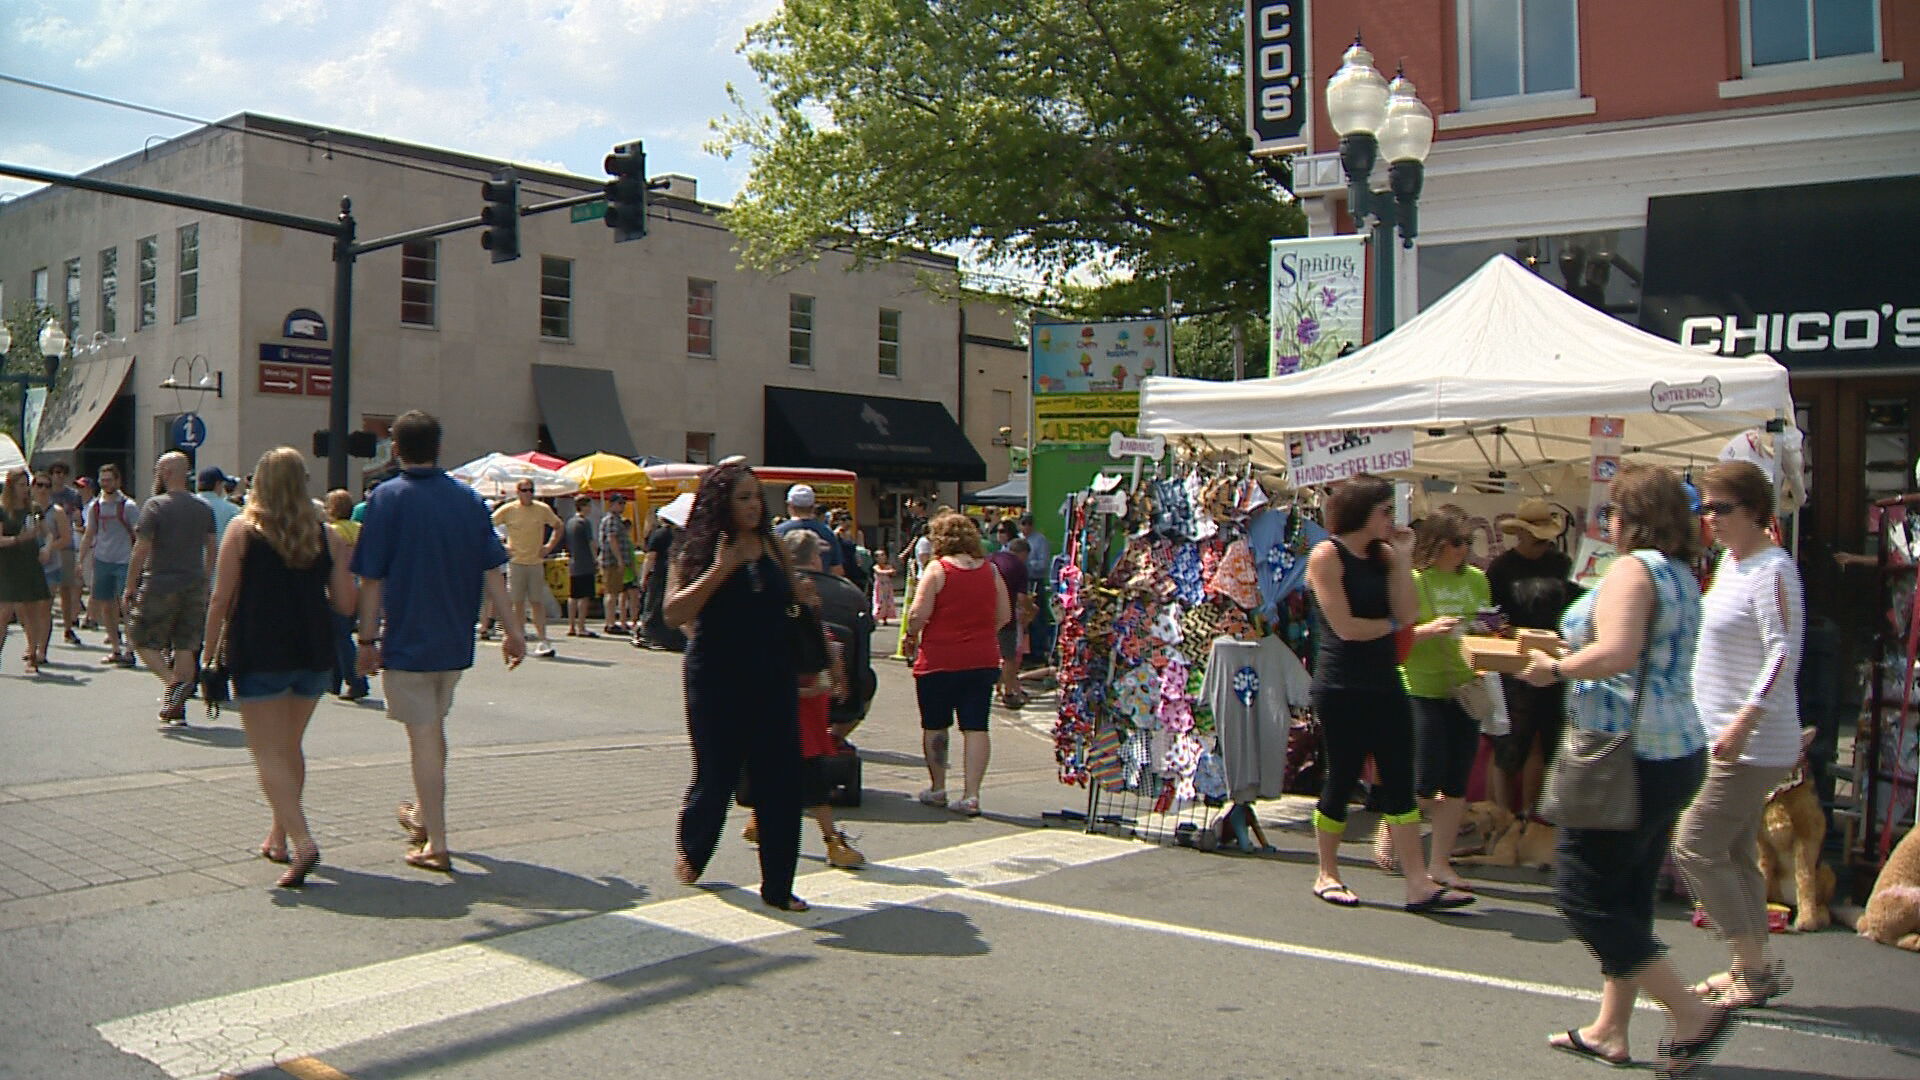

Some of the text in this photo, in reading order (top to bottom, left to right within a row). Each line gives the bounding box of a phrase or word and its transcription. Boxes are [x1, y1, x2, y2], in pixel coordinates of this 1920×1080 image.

[1278, 252, 1356, 289] Spring
[1681, 302, 1920, 355] CHICO'S
[1295, 448, 1411, 485] HANDS-FREE LEASH
